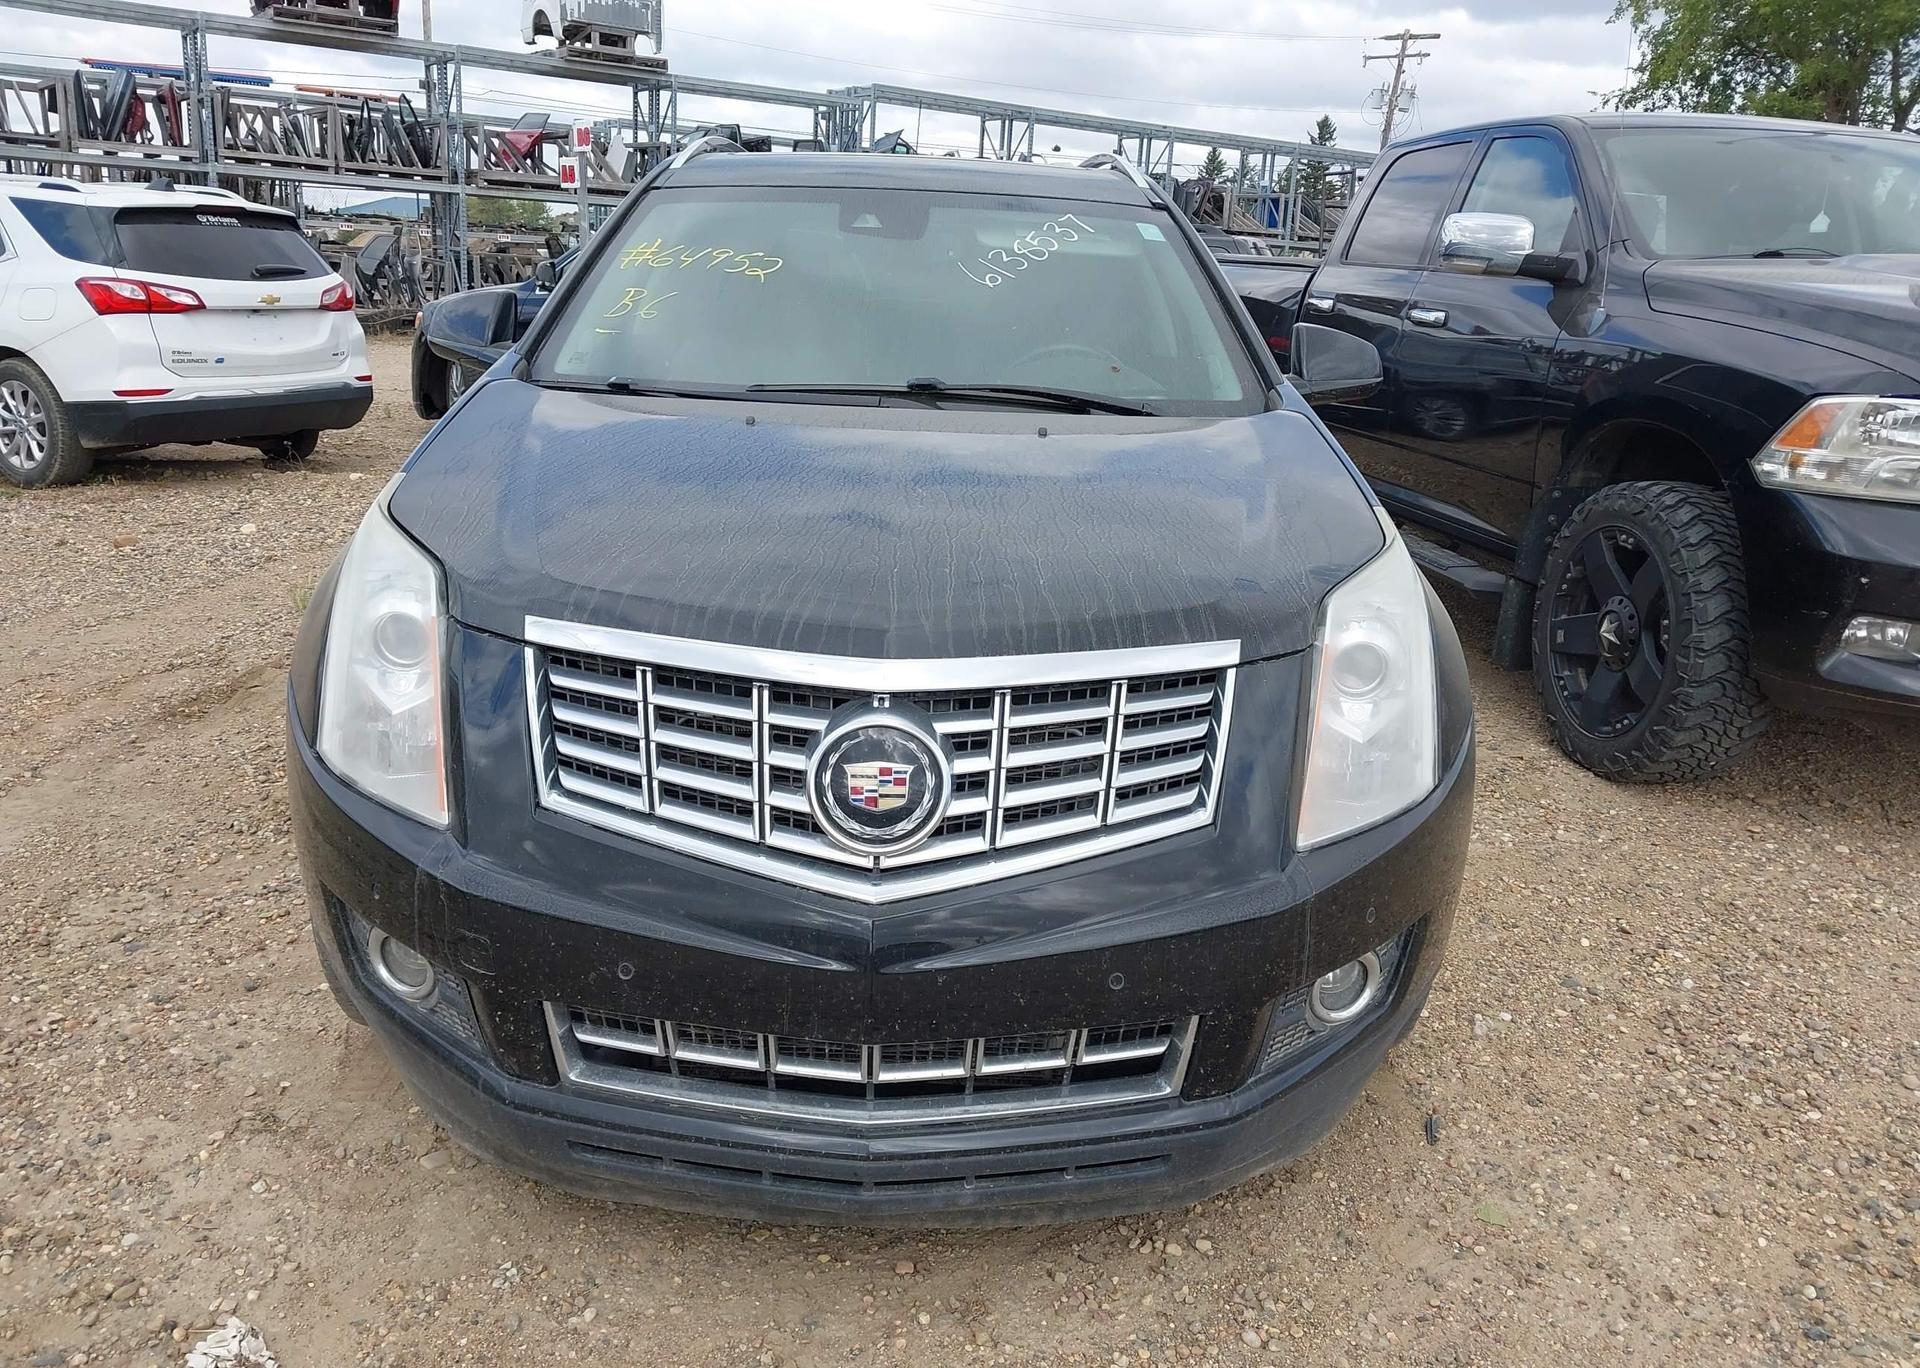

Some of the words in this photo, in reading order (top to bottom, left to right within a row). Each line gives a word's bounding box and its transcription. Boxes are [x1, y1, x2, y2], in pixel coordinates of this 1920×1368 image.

[561, 164, 576, 184] A5
[619, 238, 784, 284] #64952
[957, 213, 1096, 288] 6138537
[602, 287, 681, 320] B6
